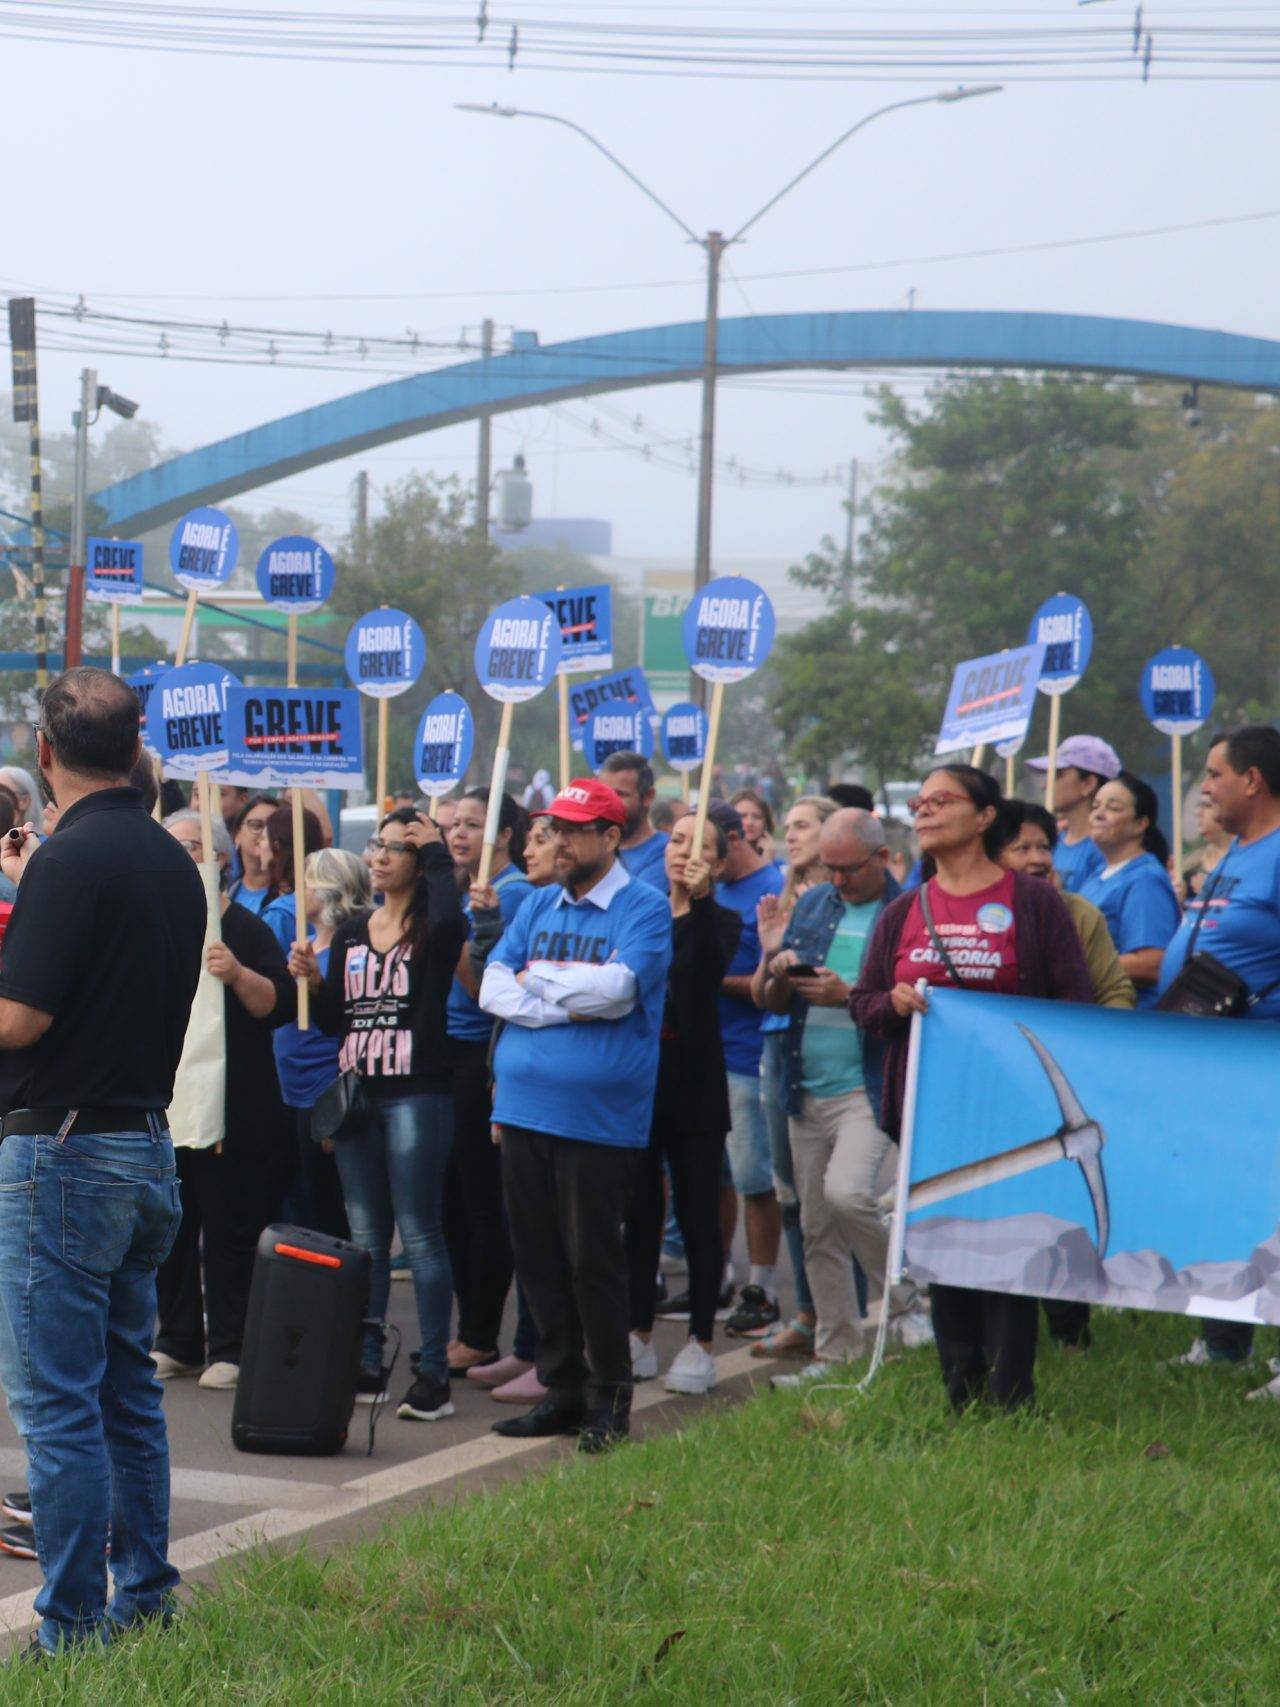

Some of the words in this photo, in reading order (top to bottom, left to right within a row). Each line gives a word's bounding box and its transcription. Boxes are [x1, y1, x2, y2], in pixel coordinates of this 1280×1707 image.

[181, 521, 220, 547] AGORA
[269, 552, 312, 574] AGORA
[697, 597, 748, 629] AGORA
[357, 626, 401, 652] AGORA
[490, 619, 538, 648] AGORA
[162, 683, 221, 719] AGORA
[244, 698, 343, 755] GREVE
[422, 713, 456, 743] AGORA
